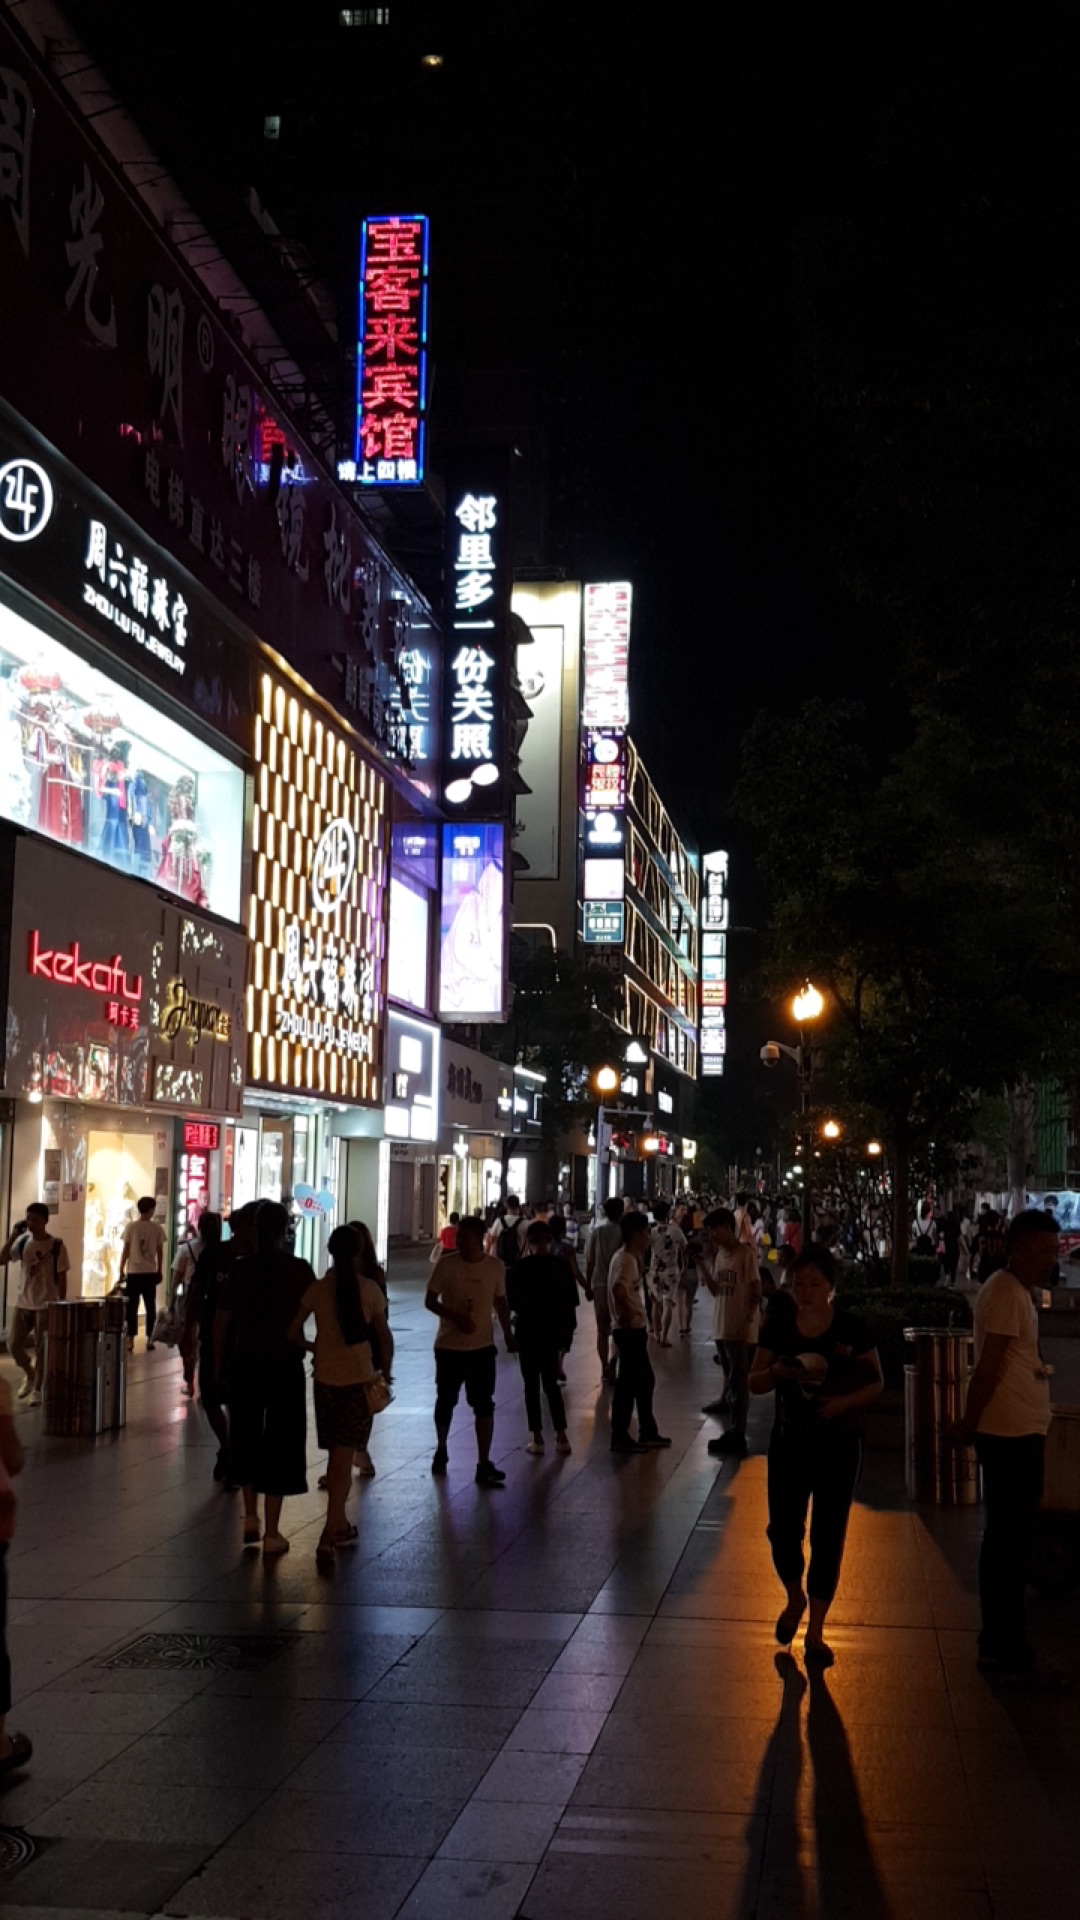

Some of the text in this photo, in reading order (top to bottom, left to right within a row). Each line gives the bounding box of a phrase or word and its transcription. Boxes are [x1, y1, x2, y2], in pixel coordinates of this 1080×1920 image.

[360, 217, 421, 459] 宝客来宾馆
[85, 519, 189, 647] 周六福珠宝
[451, 492, 498, 760] 邻里多一份关照
[26, 929, 143, 1001] kekafu
